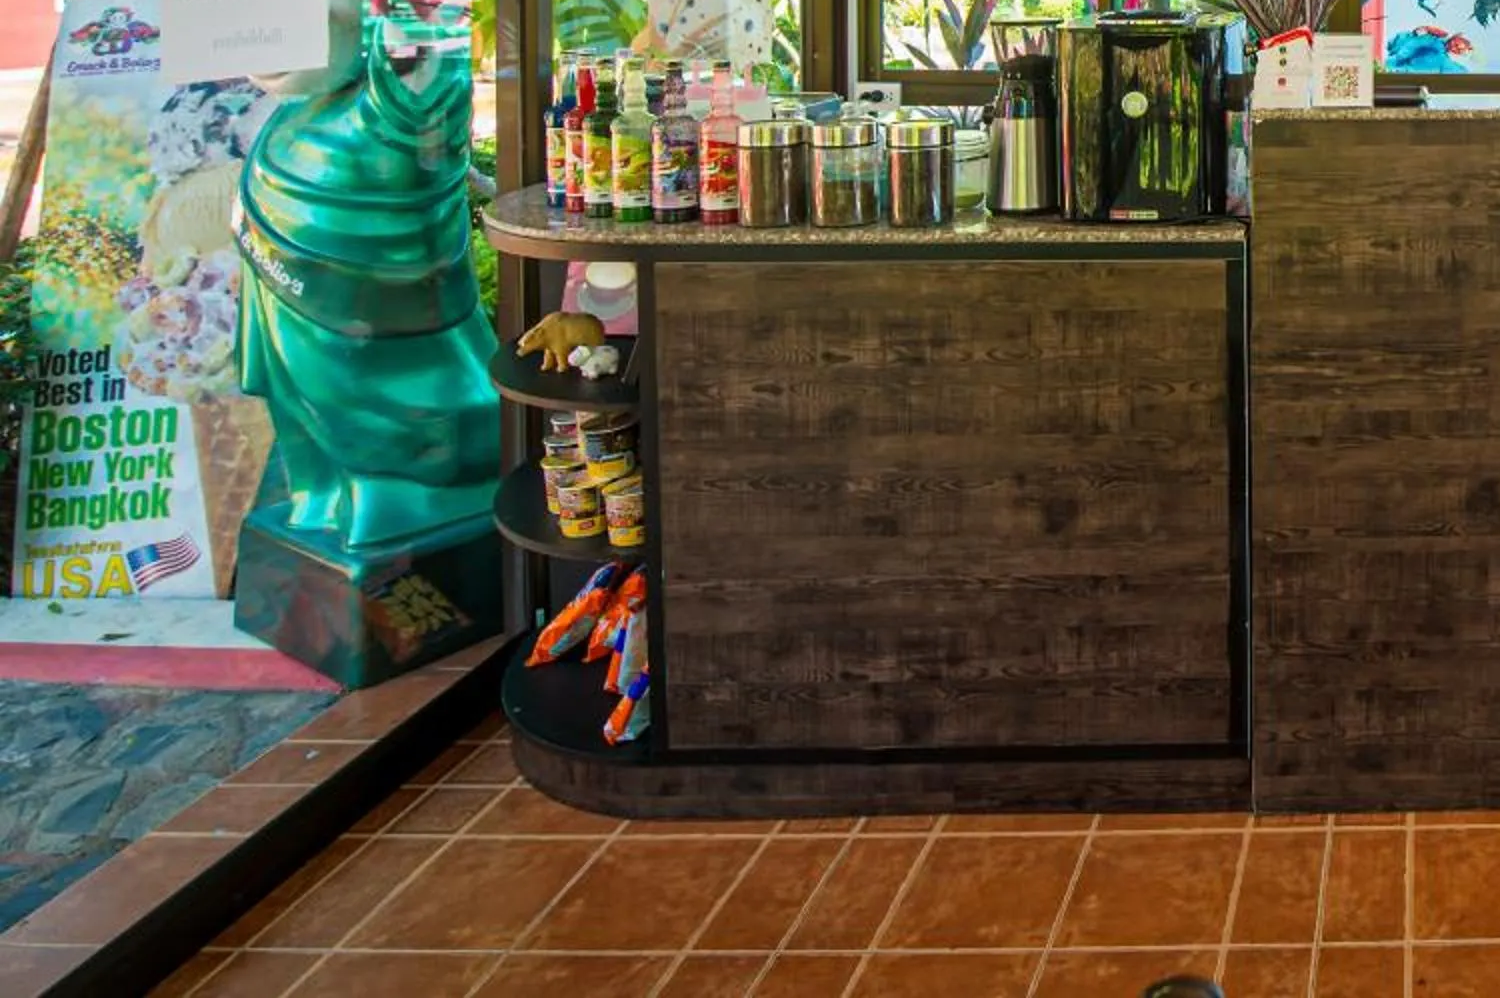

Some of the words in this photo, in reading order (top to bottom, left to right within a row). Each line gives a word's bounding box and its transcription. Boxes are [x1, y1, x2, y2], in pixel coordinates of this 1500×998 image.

[36, 344, 112, 378] Voted
[33, 377, 95, 408] Best
[102, 374, 126, 402] in
[32, 404, 178, 456] Boston
[29, 458, 95, 491] New
[104, 448, 175, 484] York
[25, 482, 173, 531] Bangkok
[22, 553, 136, 599] USA
